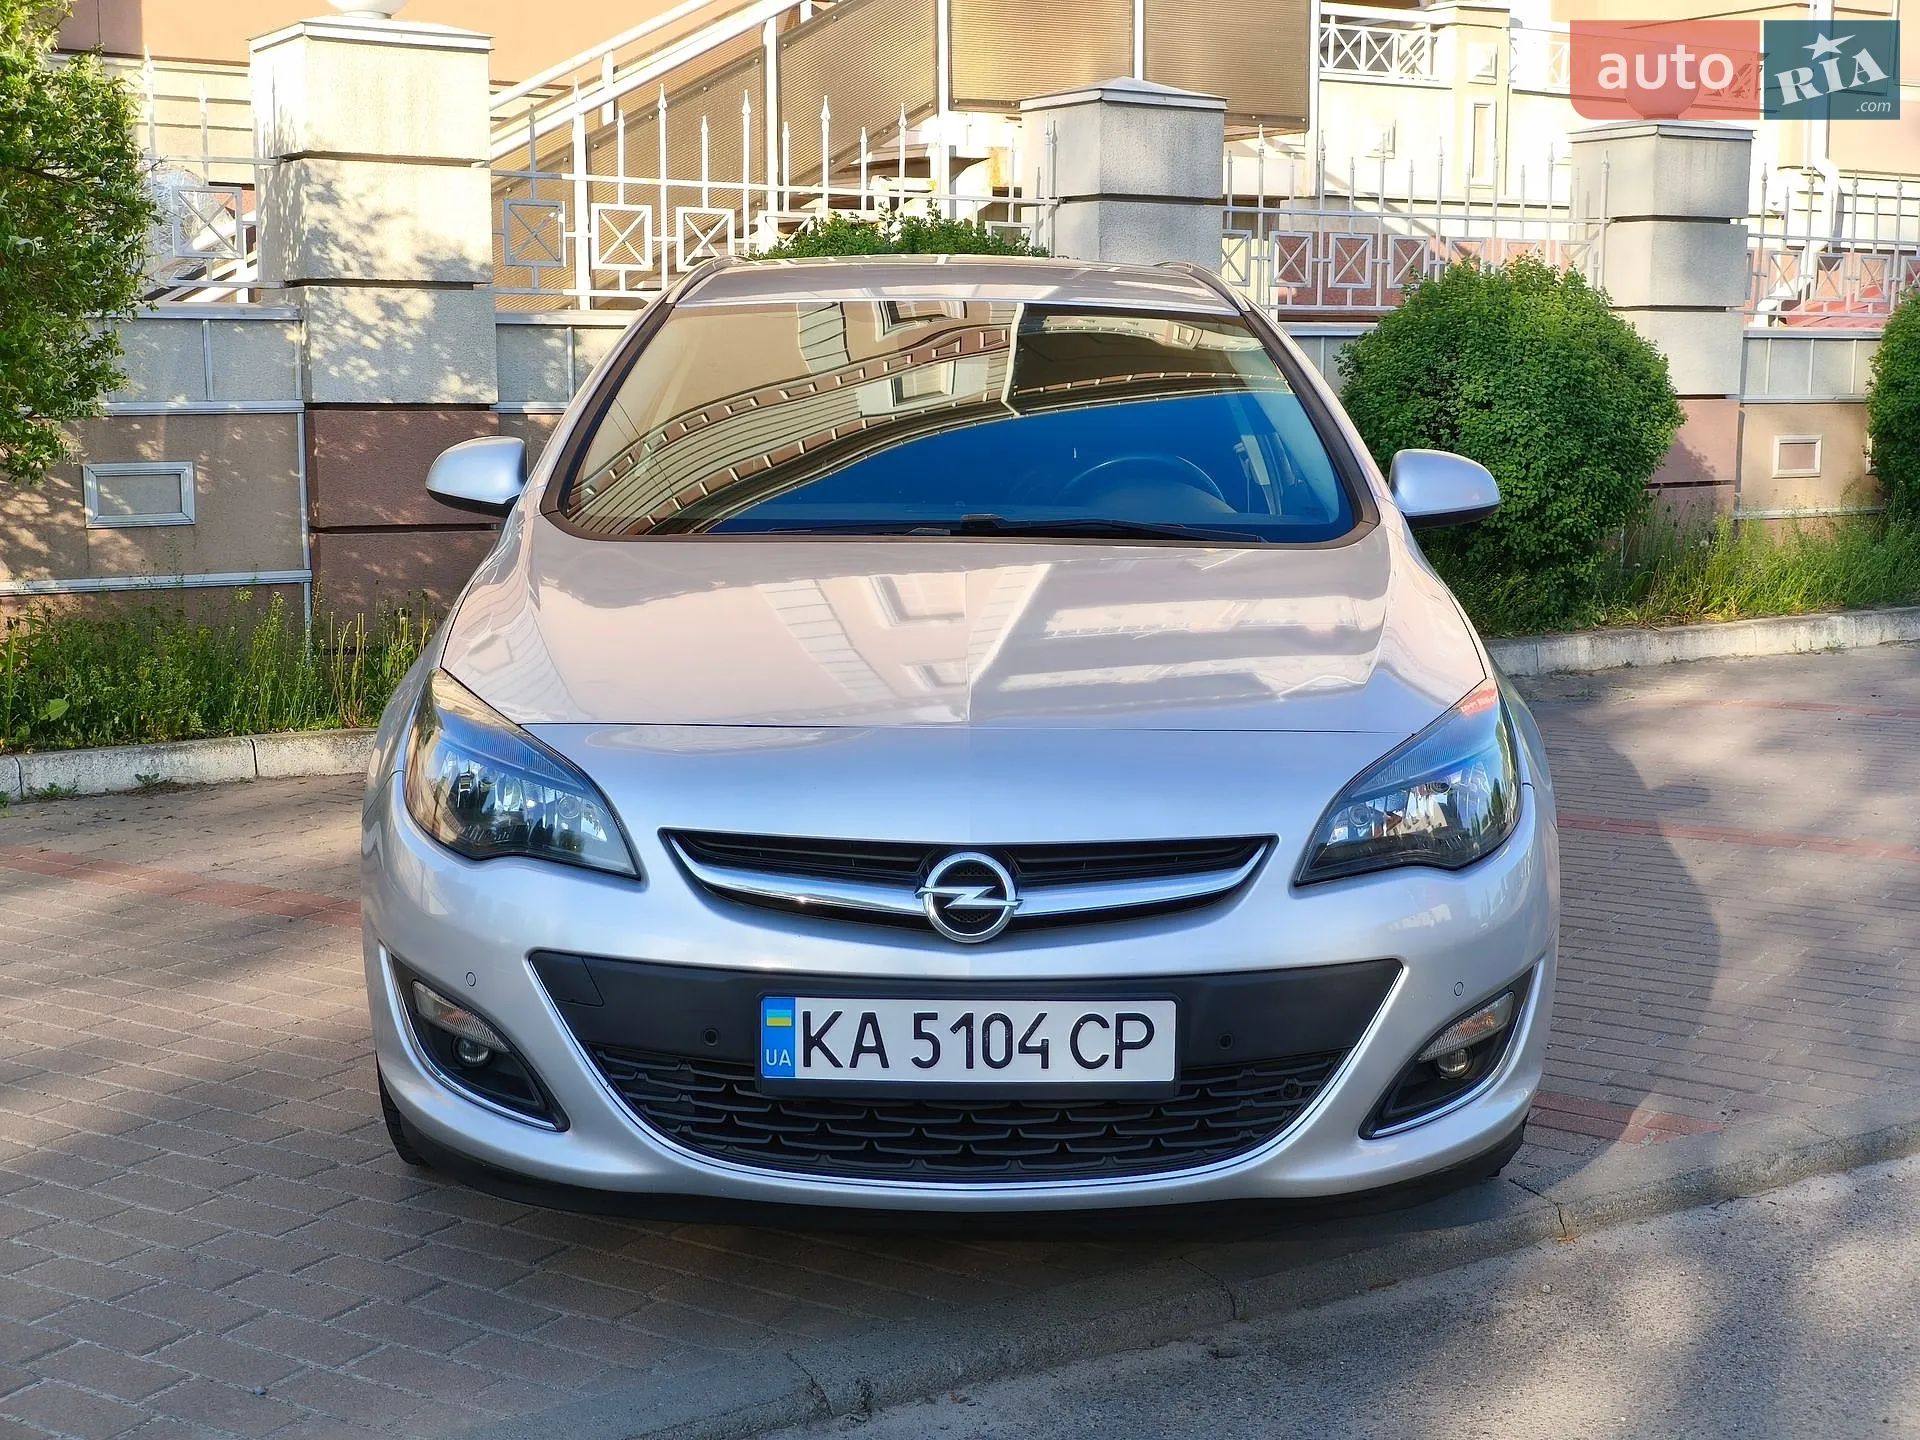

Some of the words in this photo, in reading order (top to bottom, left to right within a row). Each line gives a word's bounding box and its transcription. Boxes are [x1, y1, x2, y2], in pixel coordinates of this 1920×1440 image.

[765, 1049, 792, 1067] UA
[802, 1011, 890, 1069] KA
[911, 1012, 1050, 1070] 5104
[1069, 1013, 1155, 1070] CP
